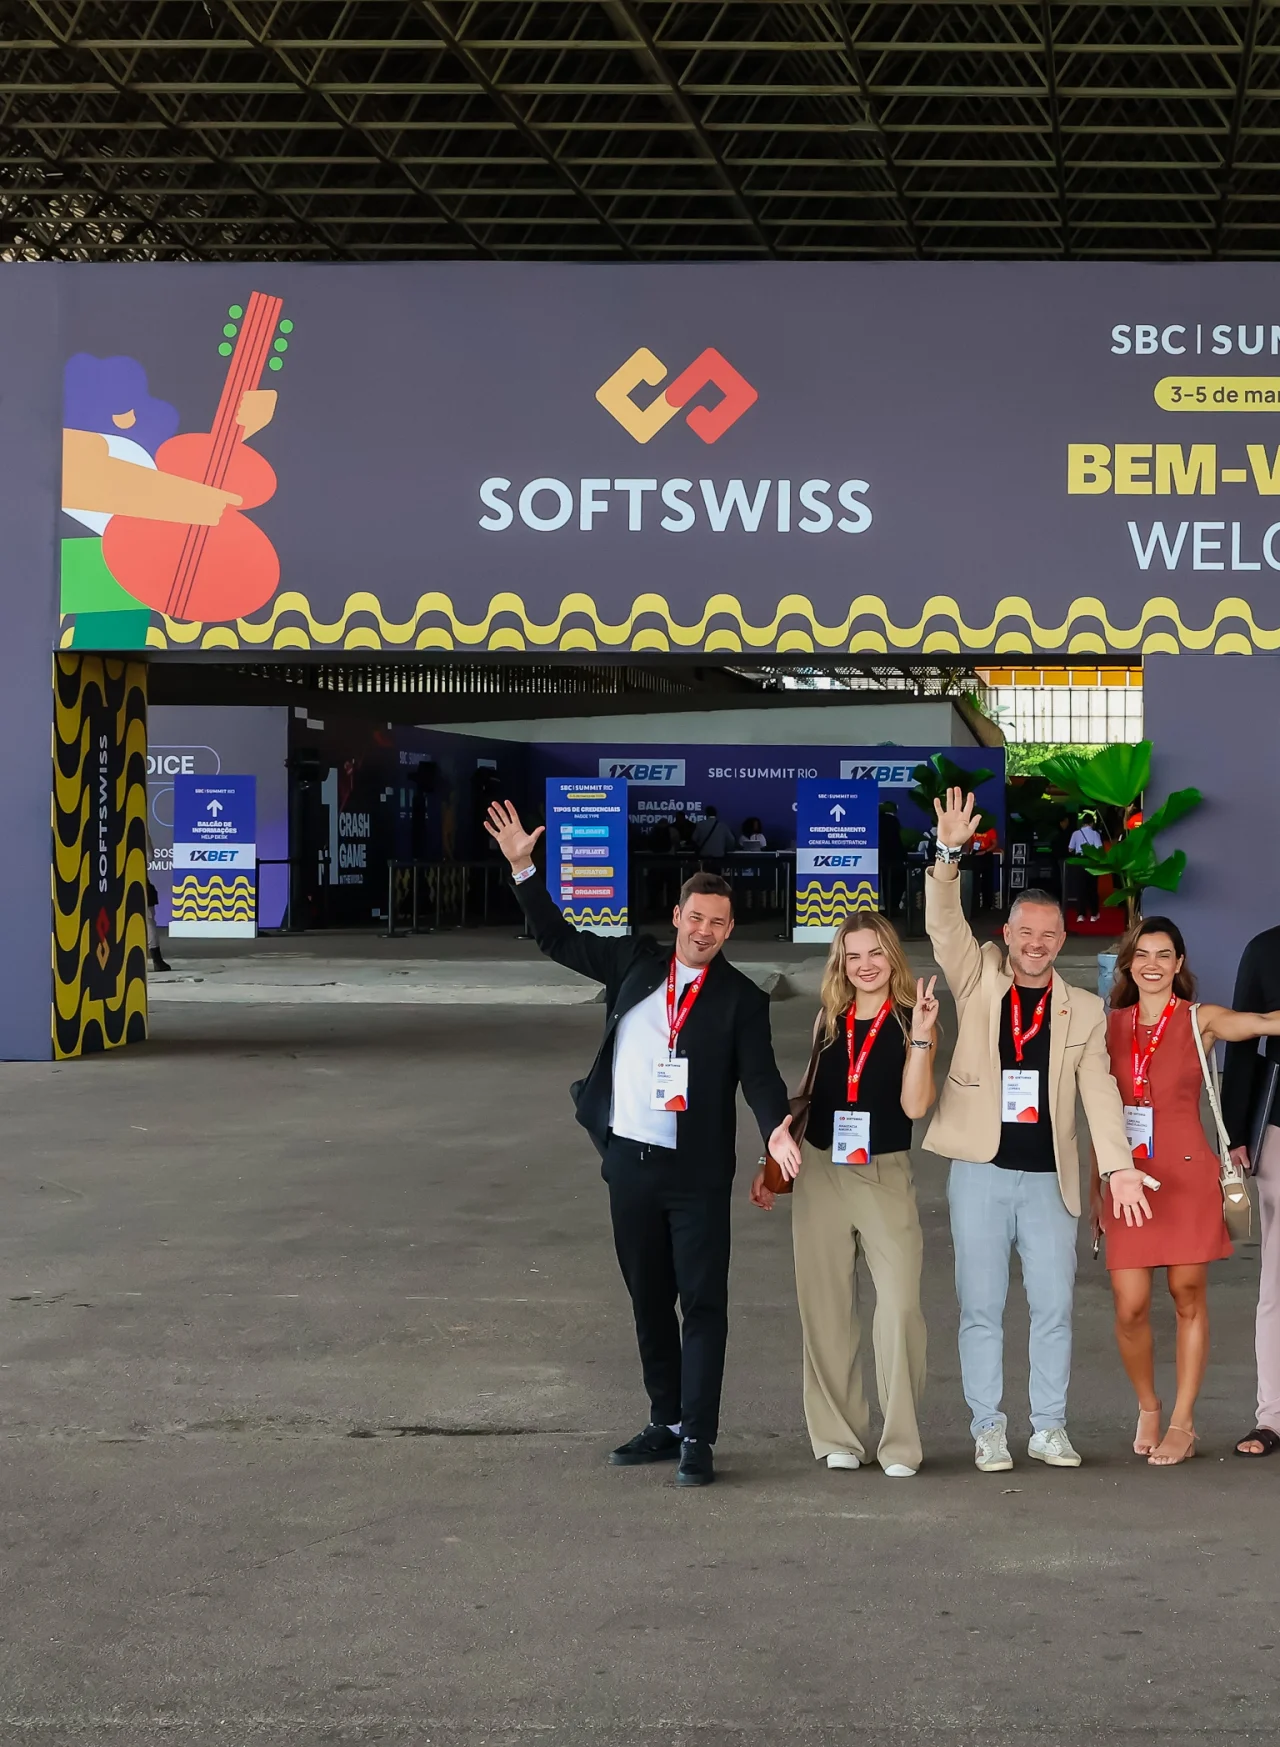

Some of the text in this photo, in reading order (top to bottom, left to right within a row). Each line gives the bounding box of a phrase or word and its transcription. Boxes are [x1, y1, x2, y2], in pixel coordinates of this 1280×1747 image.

[1110, 324, 1187, 355] SBC
[1212, 385, 1239, 403] de
[478, 476, 873, 534] SOFTSWISS
[609, 764, 678, 781] 1XBET
[708, 768, 818, 779] SBC SUMMIT RIO
[98, 733, 108, 893] SOFTSWISS
[637, 799, 702, 811] BALCÃO DE
[339, 812, 370, 838] CRASH
[189, 850, 239, 862] 1XBET
[339, 843, 366, 868] GAME
[813, 855, 862, 867] 1XBET
